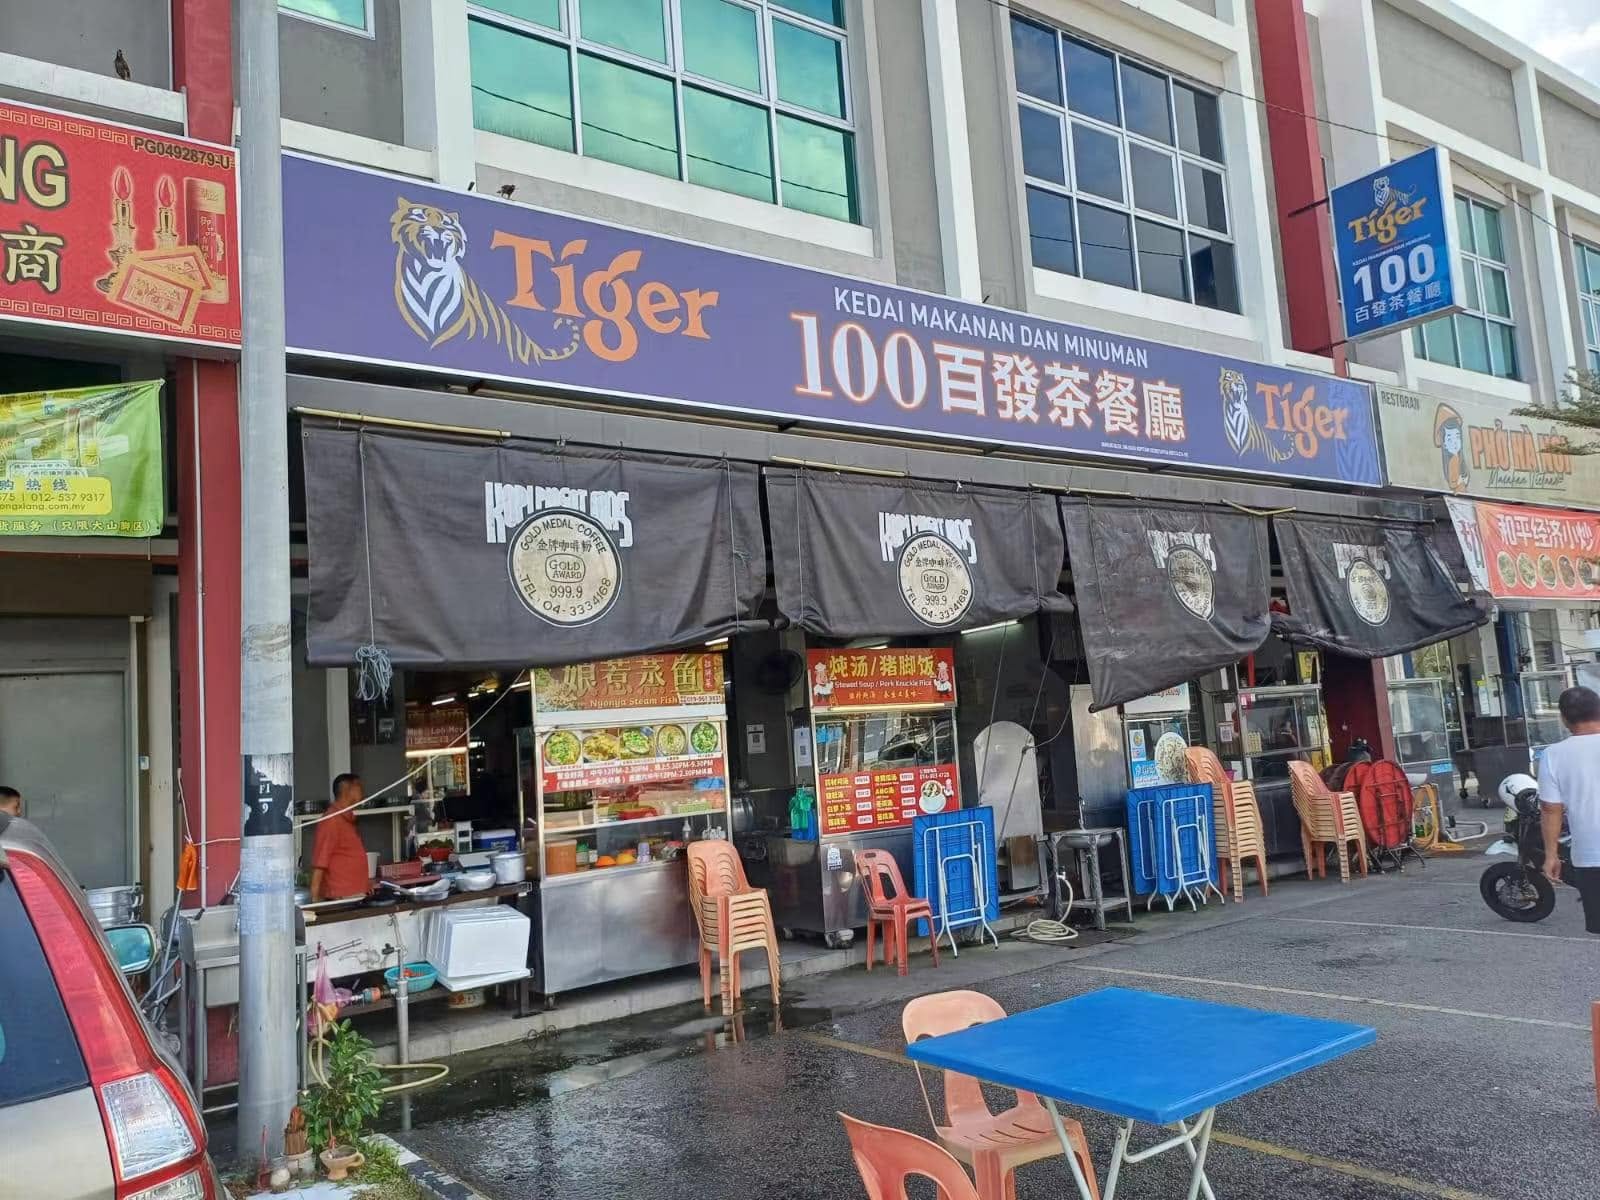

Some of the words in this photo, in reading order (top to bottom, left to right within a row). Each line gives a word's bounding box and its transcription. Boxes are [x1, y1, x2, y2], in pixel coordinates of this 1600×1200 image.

[1348, 196, 1428, 245] Tiger
[0, 225, 64, 293] 商
[1353, 243, 1435, 303] 100
[490, 230, 719, 362] Tiger
[834, 287, 904, 323] KEDAI
[910, 302, 1016, 345] MAKANAN
[1020, 324, 1060, 352] DAN
[1064, 335, 1149, 369] MINUMAN
[790, 311, 930, 411] 100
[932, 340, 1188, 443] 百發茶餐廳
[1381, 391, 1420, 410] RESTORAN
[1255, 381, 1348, 459] Tiger
[520, 525, 542, 552] GOLD
[542, 518, 574, 531] MEDAL
[577, 523, 607, 555] COFFEE
[917, 540, 941, 550] MEDAL
[1497, 513, 1594, 551] 和平经济小炒
[549, 559, 581, 571] GOLD
[552, 570, 583, 579] AWARD
[923, 574, 945, 583] GOLD
[549, 586, 583, 599] 999.9
[562, 654, 704, 696] 娘惹蒸鱼
[859, 681, 875, 690] Soup
[880, 680, 894, 688] Pork
[630, 697, 657, 706] Steam
[660, 696, 677, 705] Fish
[262, 803, 269, 815] 9
